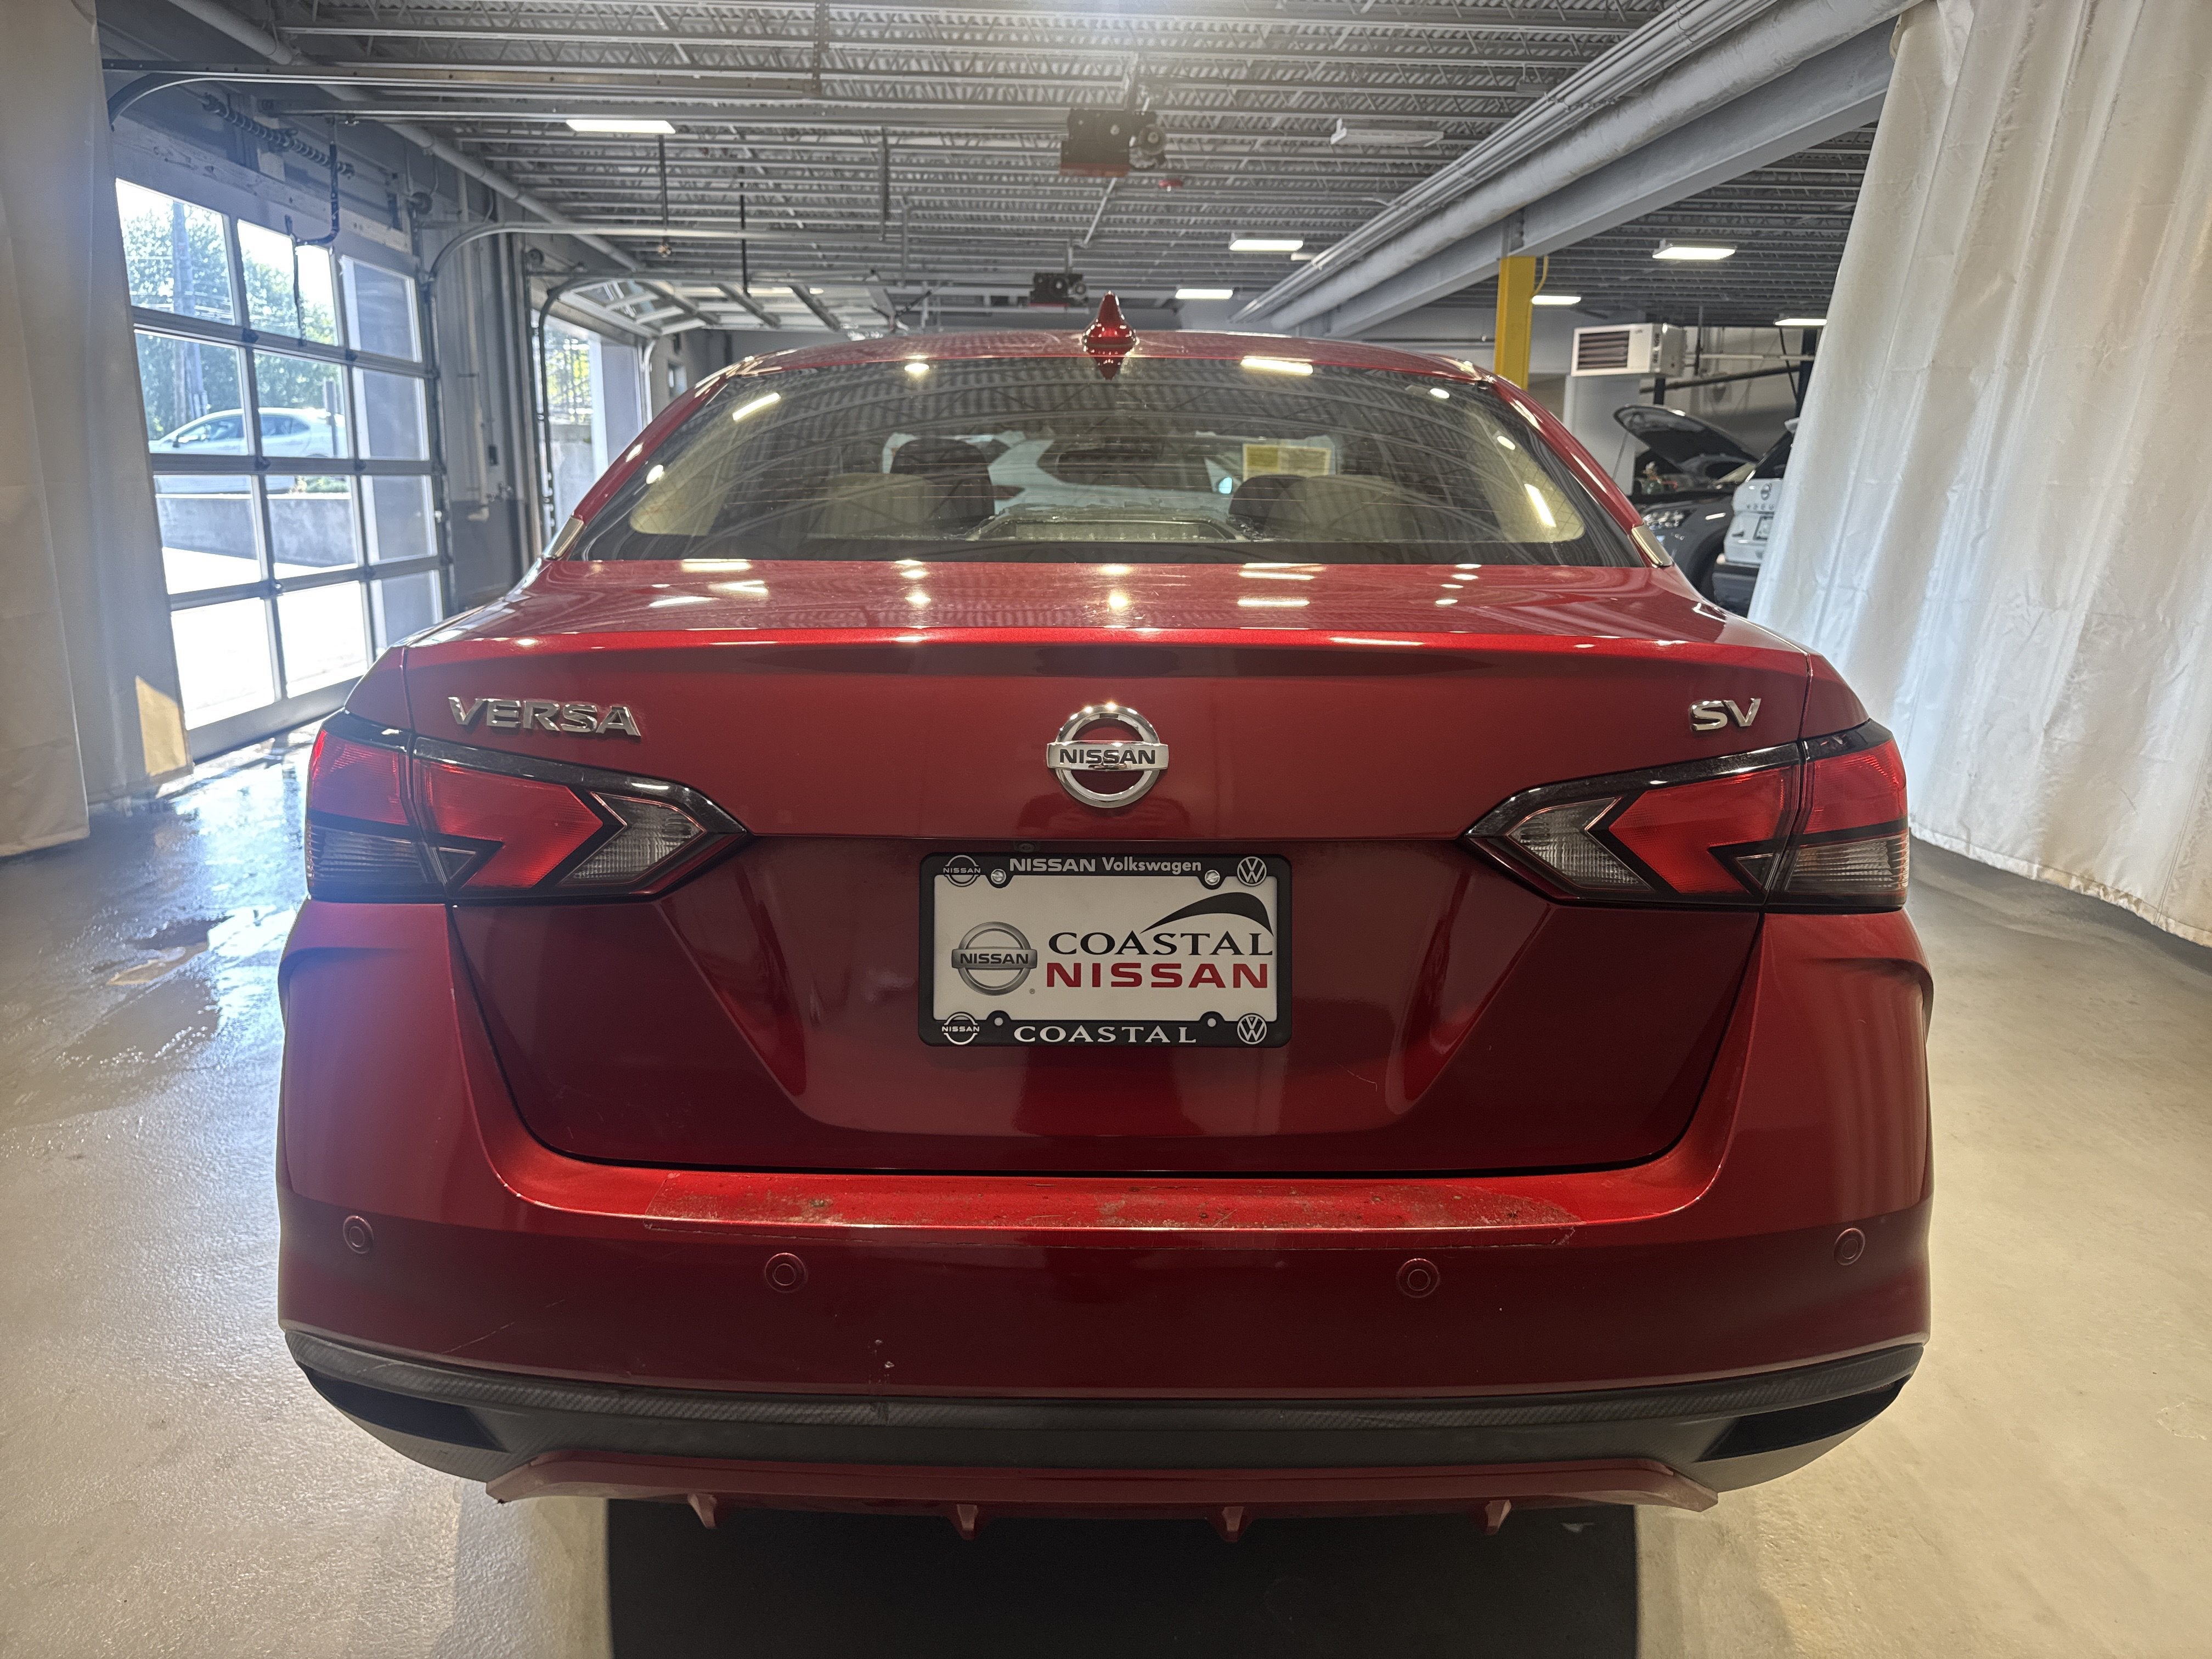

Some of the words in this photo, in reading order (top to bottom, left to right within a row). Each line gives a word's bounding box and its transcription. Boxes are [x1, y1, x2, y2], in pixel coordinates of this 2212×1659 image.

[448, 697, 642, 737] VERSA
[1690, 698, 1762, 731] SV
[1059, 748, 1155, 764] NISSAN
[1010, 858, 1096, 872] NISSAN
[1102, 856, 1201, 874] Volkswagen
[1048, 931, 1273, 956] COASTAL
[960, 953, 1029, 964] NISSAN
[1047, 962, 1267, 988] NISSAN
[1014, 1025, 1197, 1043] COASTAL
